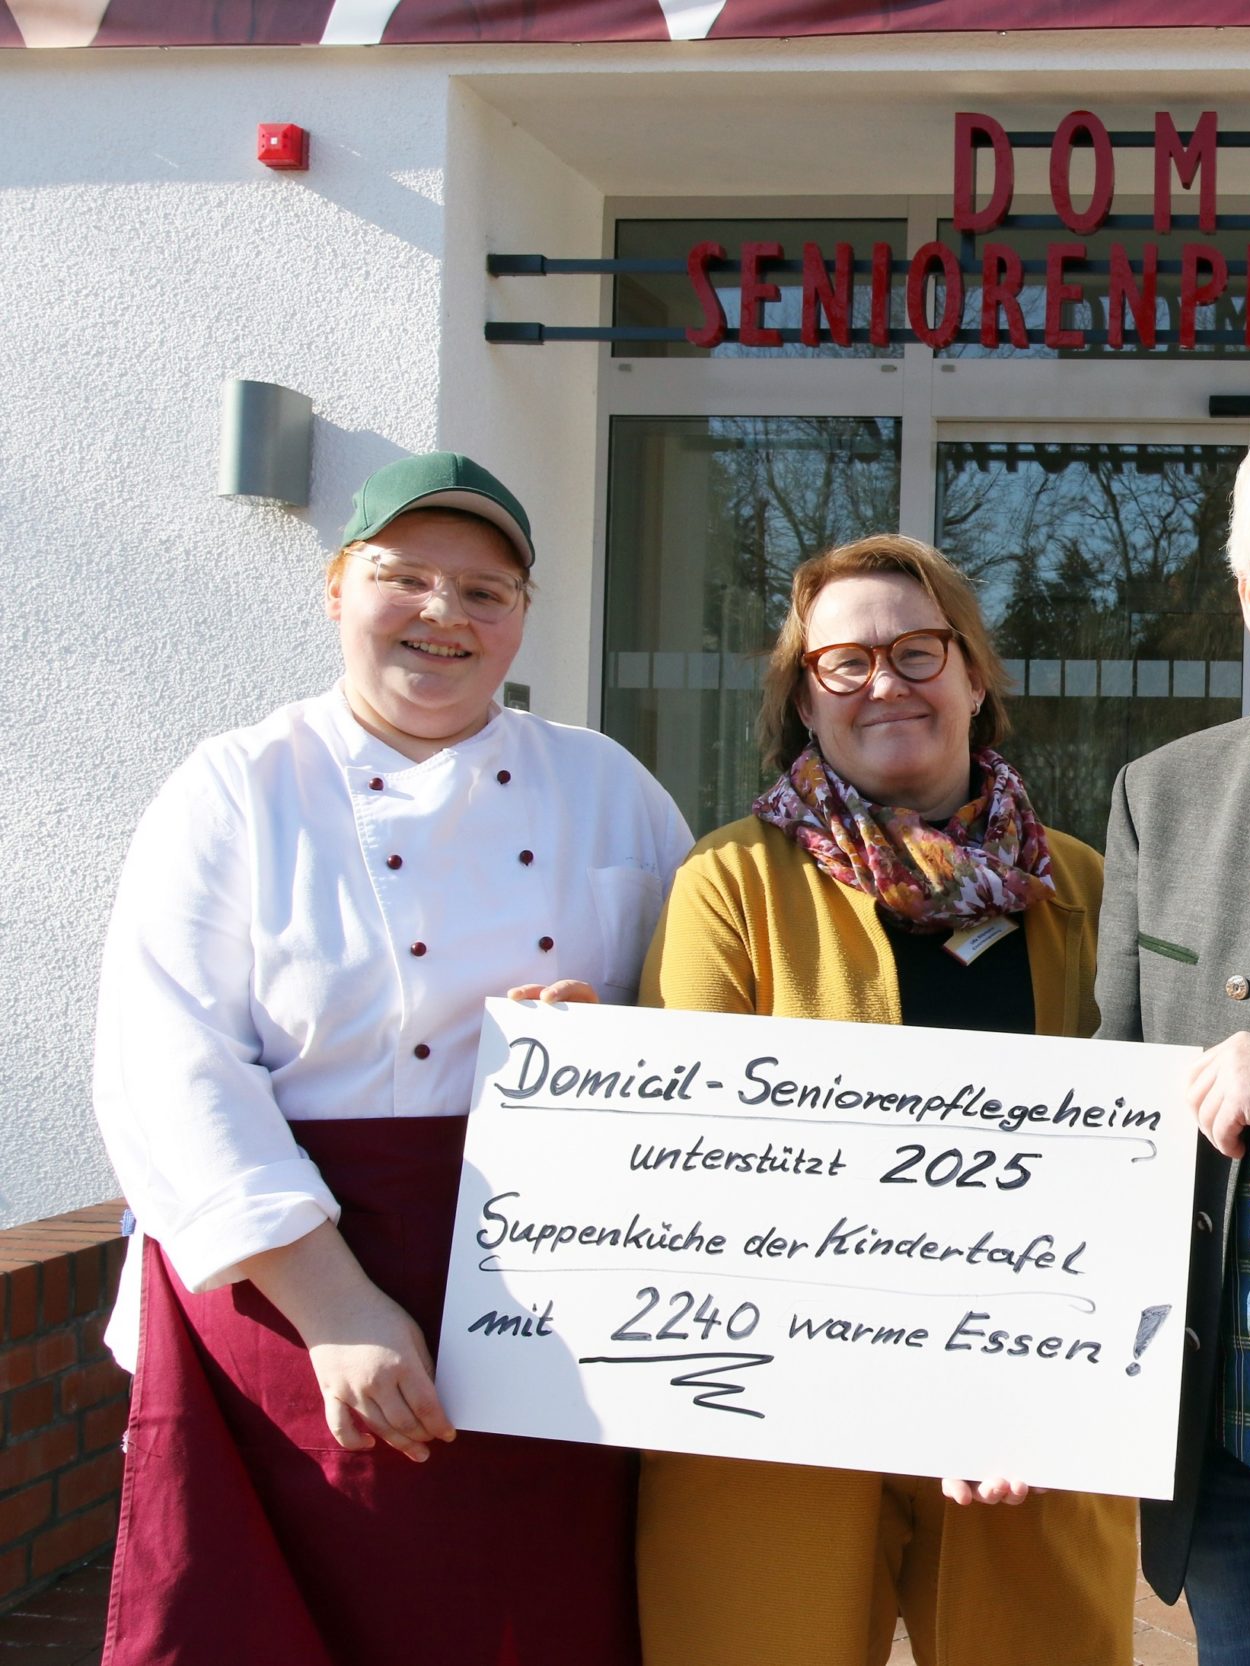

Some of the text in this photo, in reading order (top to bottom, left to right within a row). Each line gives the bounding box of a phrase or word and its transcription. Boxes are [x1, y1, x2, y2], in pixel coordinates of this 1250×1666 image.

[630, 1134, 1044, 1191] unterstützt 2025
[476, 1191, 1088, 1276] Suppenküche der Kindertafel
[468, 1302, 556, 1339] mit
[610, 1286, 761, 1343] 2240
[787, 1310, 929, 1349] warme
